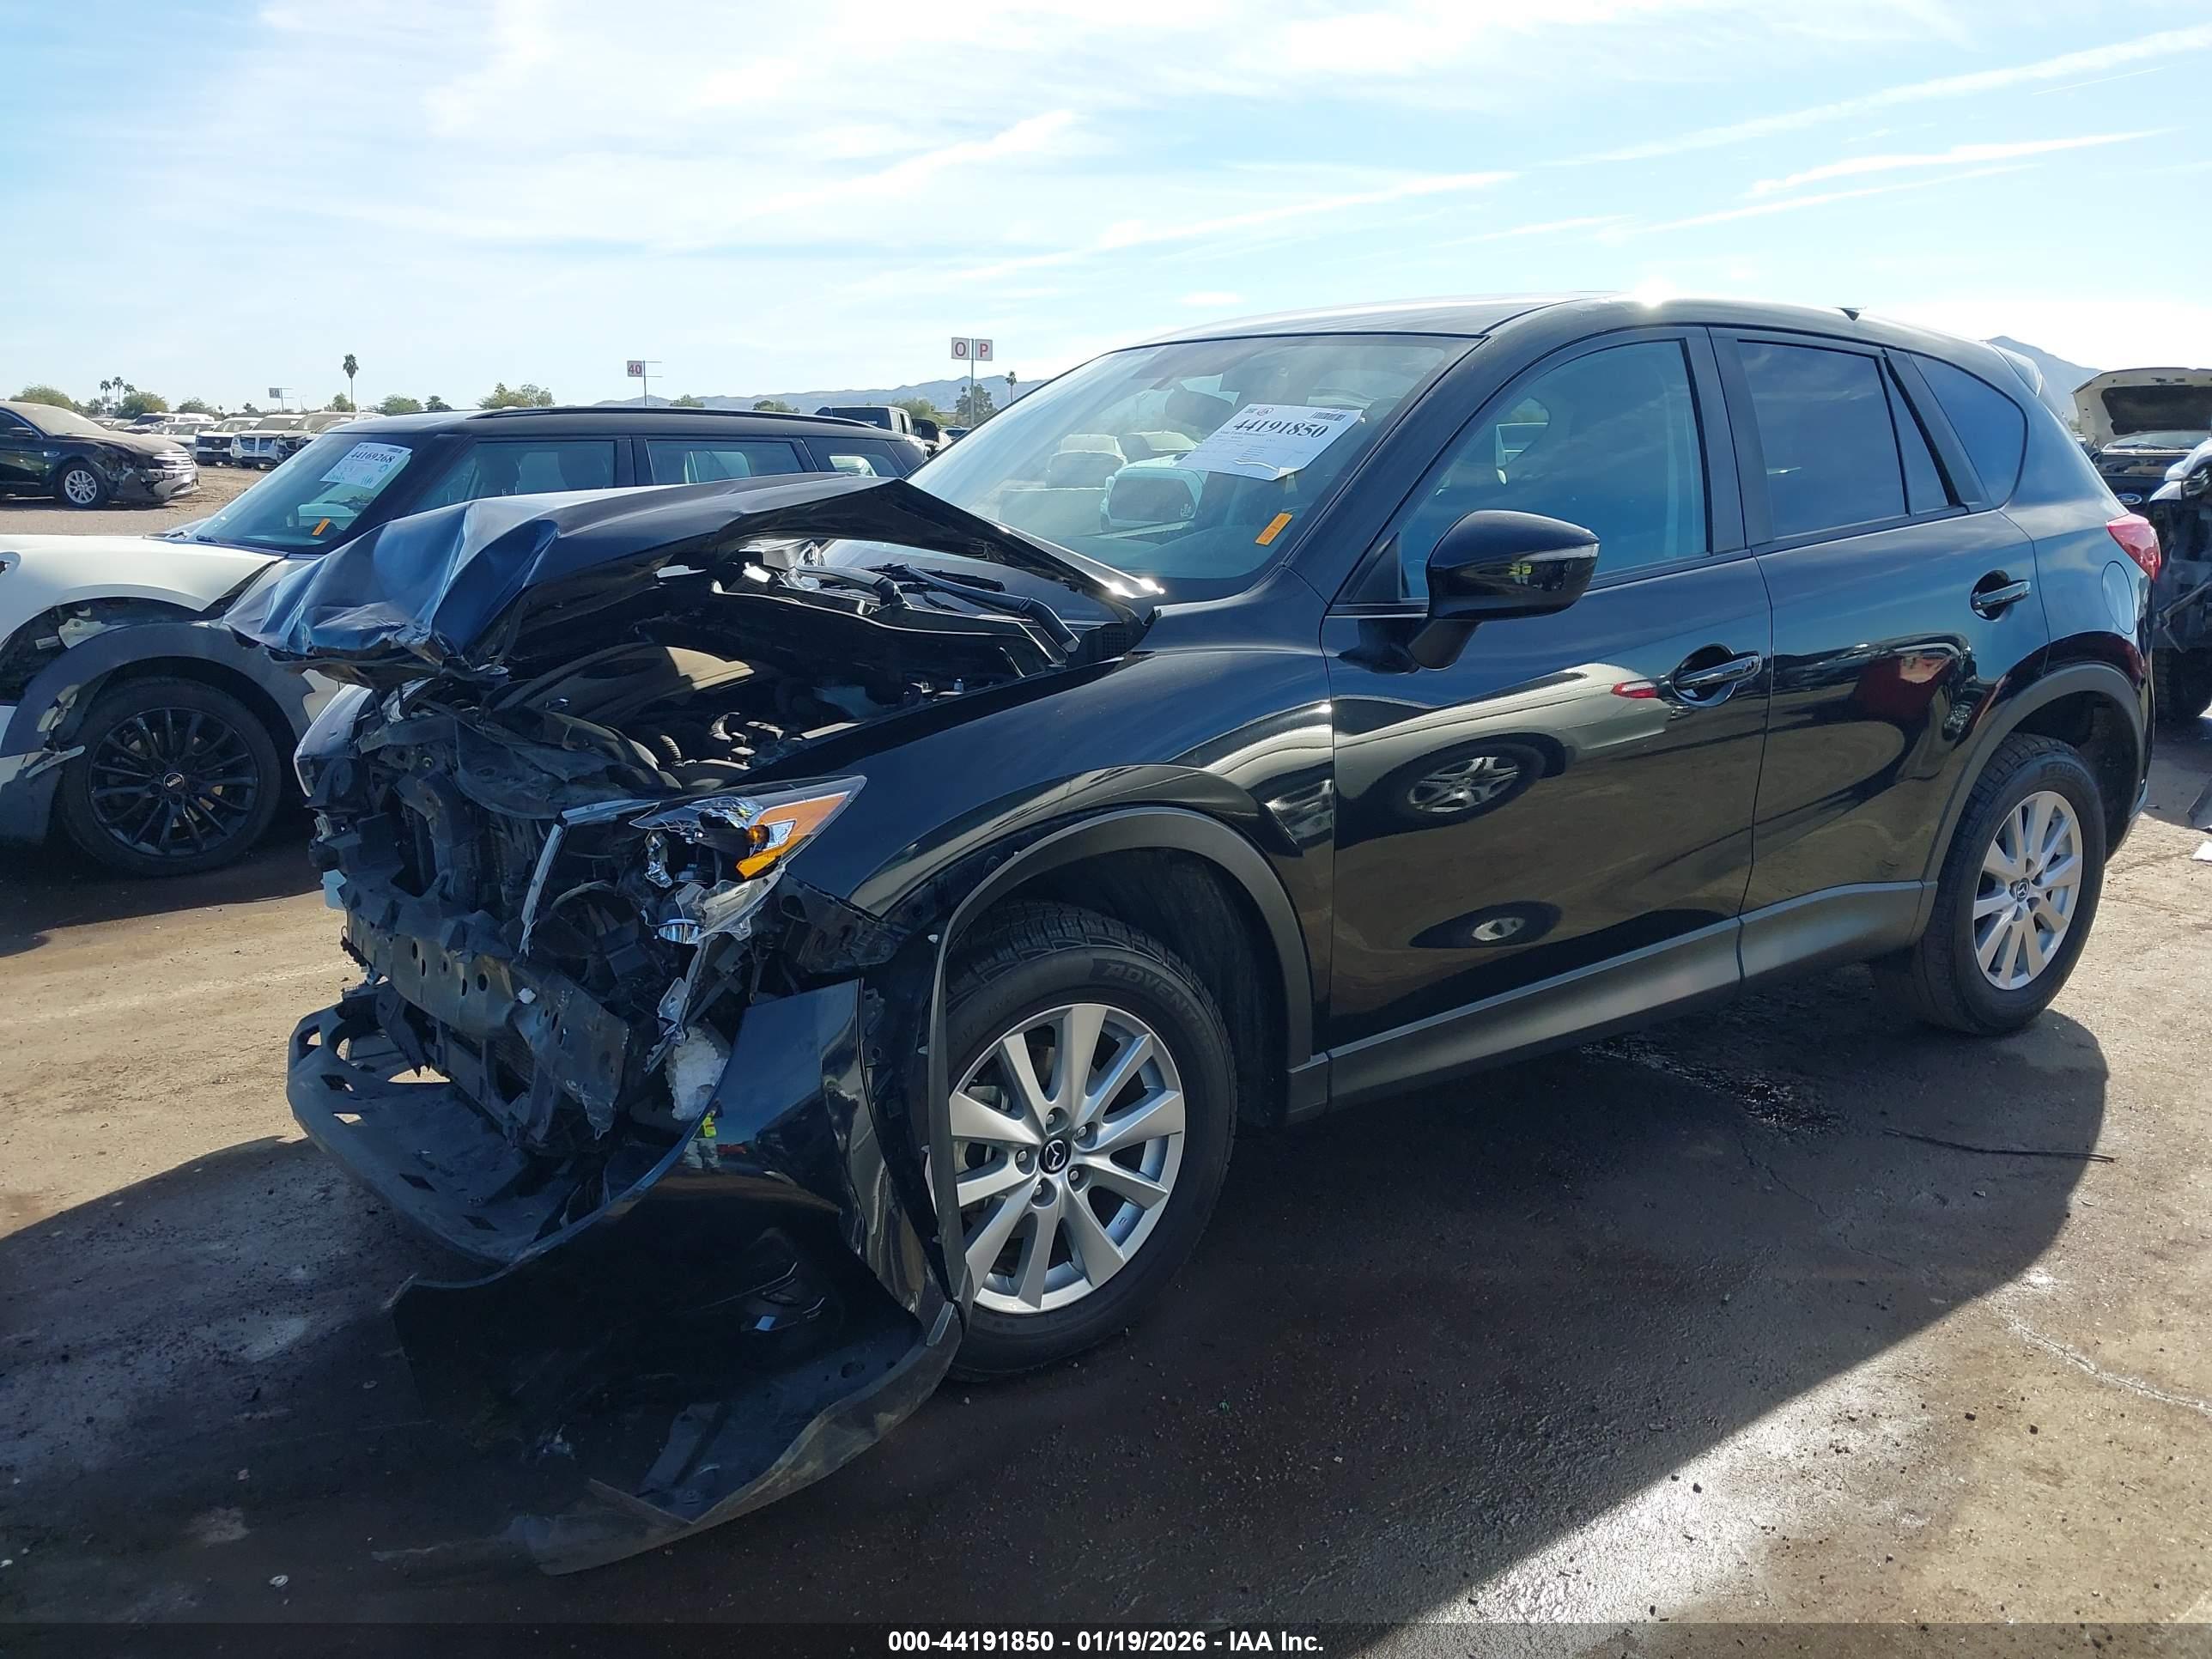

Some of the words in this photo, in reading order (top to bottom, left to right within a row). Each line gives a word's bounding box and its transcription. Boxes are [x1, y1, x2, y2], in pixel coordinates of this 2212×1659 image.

[955, 342, 966, 356] O
[980, 343, 988, 357] P
[629, 364, 641, 374] 40
[1233, 419, 1329, 439] 44191850
[350, 451, 396, 464] 44169268
